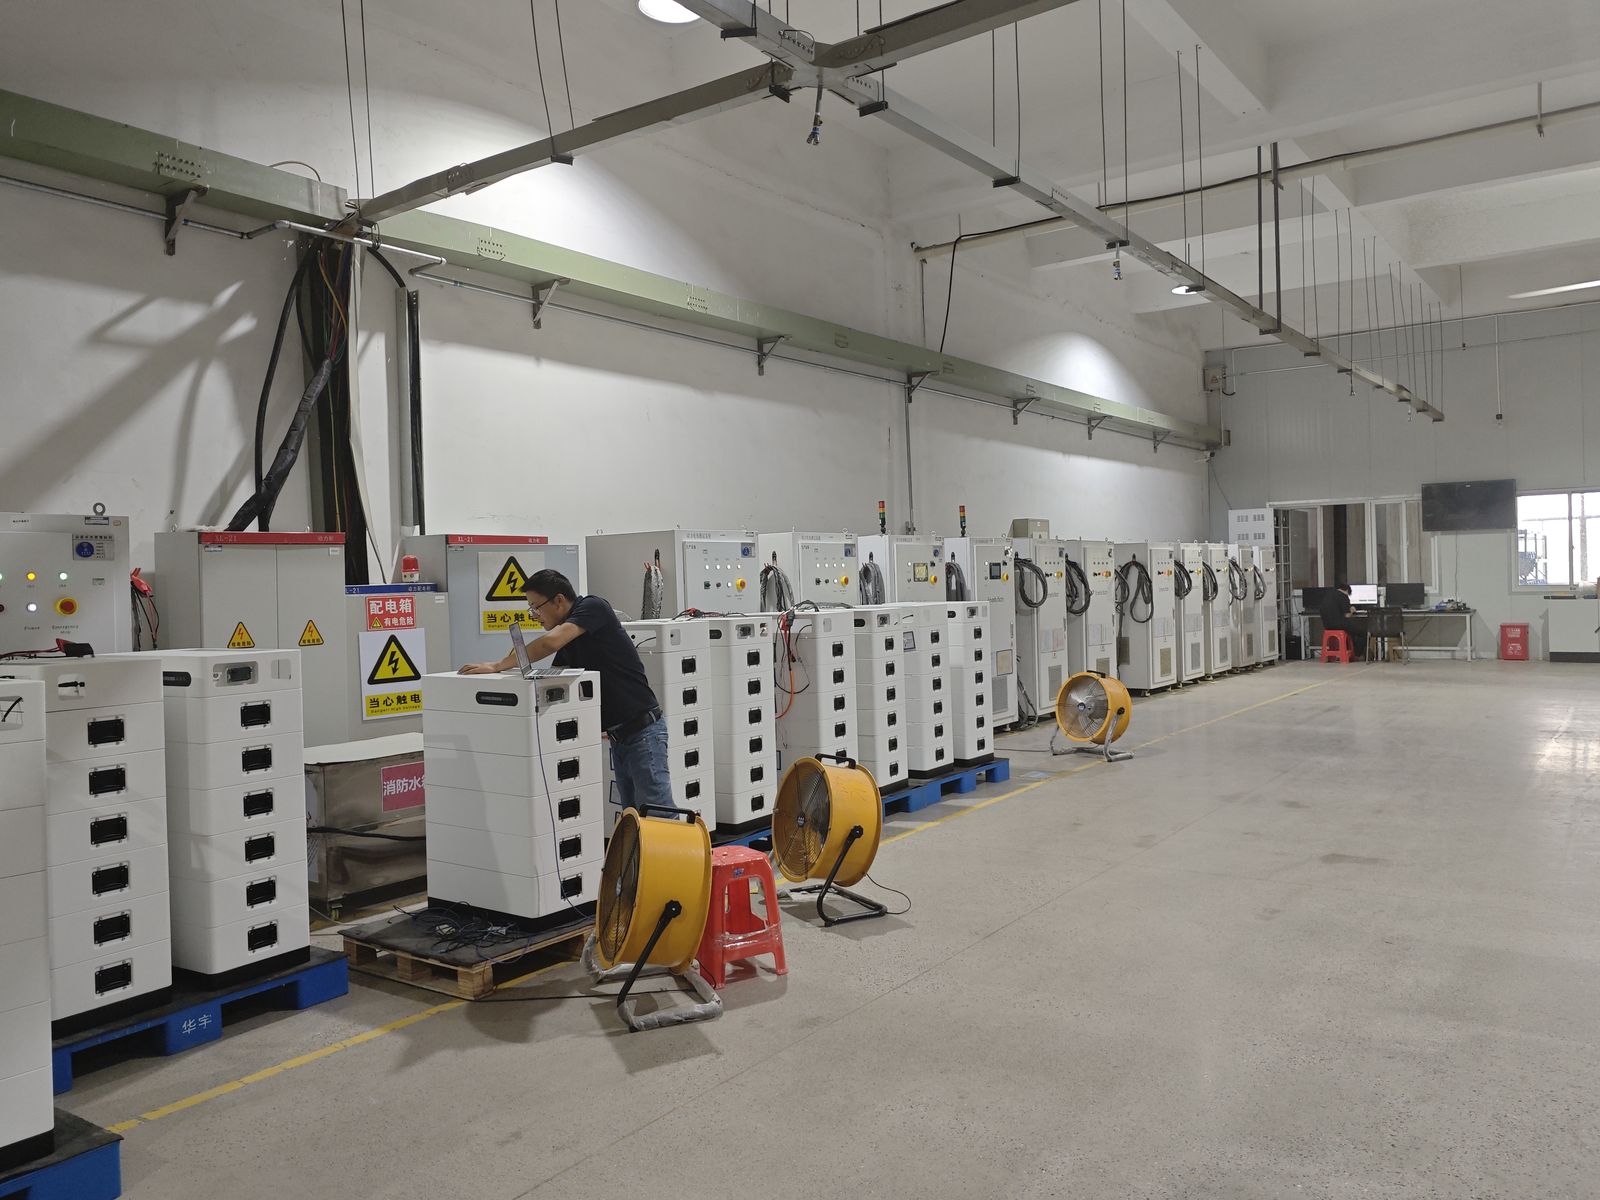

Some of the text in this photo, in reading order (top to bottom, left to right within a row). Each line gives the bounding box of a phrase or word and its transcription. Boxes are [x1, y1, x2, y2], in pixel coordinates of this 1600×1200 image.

[369, 598, 412, 615] 配电箱
[383, 616, 414, 627] 有电危险
[369, 693, 421, 708] 当心触电
[384, 775, 424, 796] 消防水
[182, 1015, 212, 1034] 华宇
